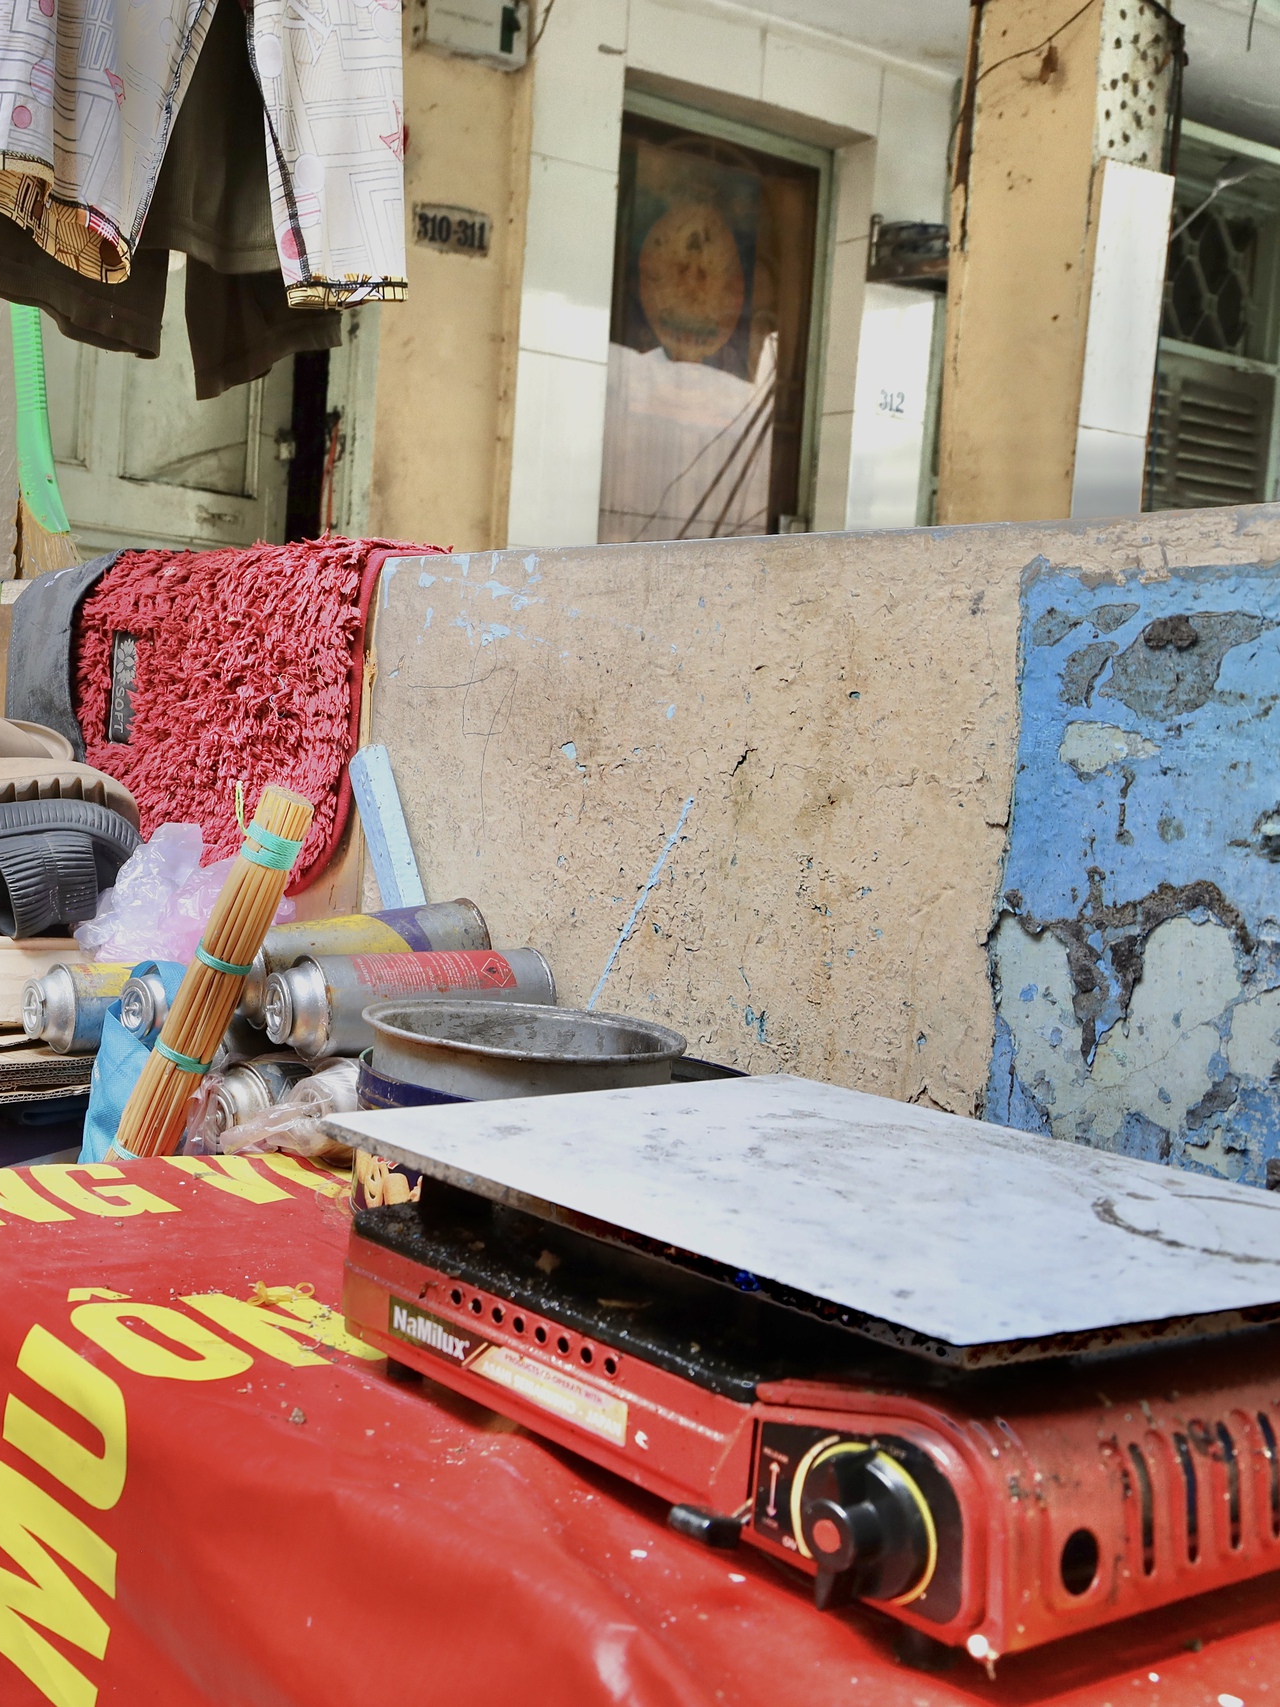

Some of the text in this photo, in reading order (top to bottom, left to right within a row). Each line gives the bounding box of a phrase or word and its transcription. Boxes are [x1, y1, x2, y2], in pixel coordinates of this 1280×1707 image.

[417, 212, 487, 250] 310-311
[879, 389, 905, 414] 312
[113, 685, 125, 734] SOFT
[393, 1304, 466, 1361] NaMilux
